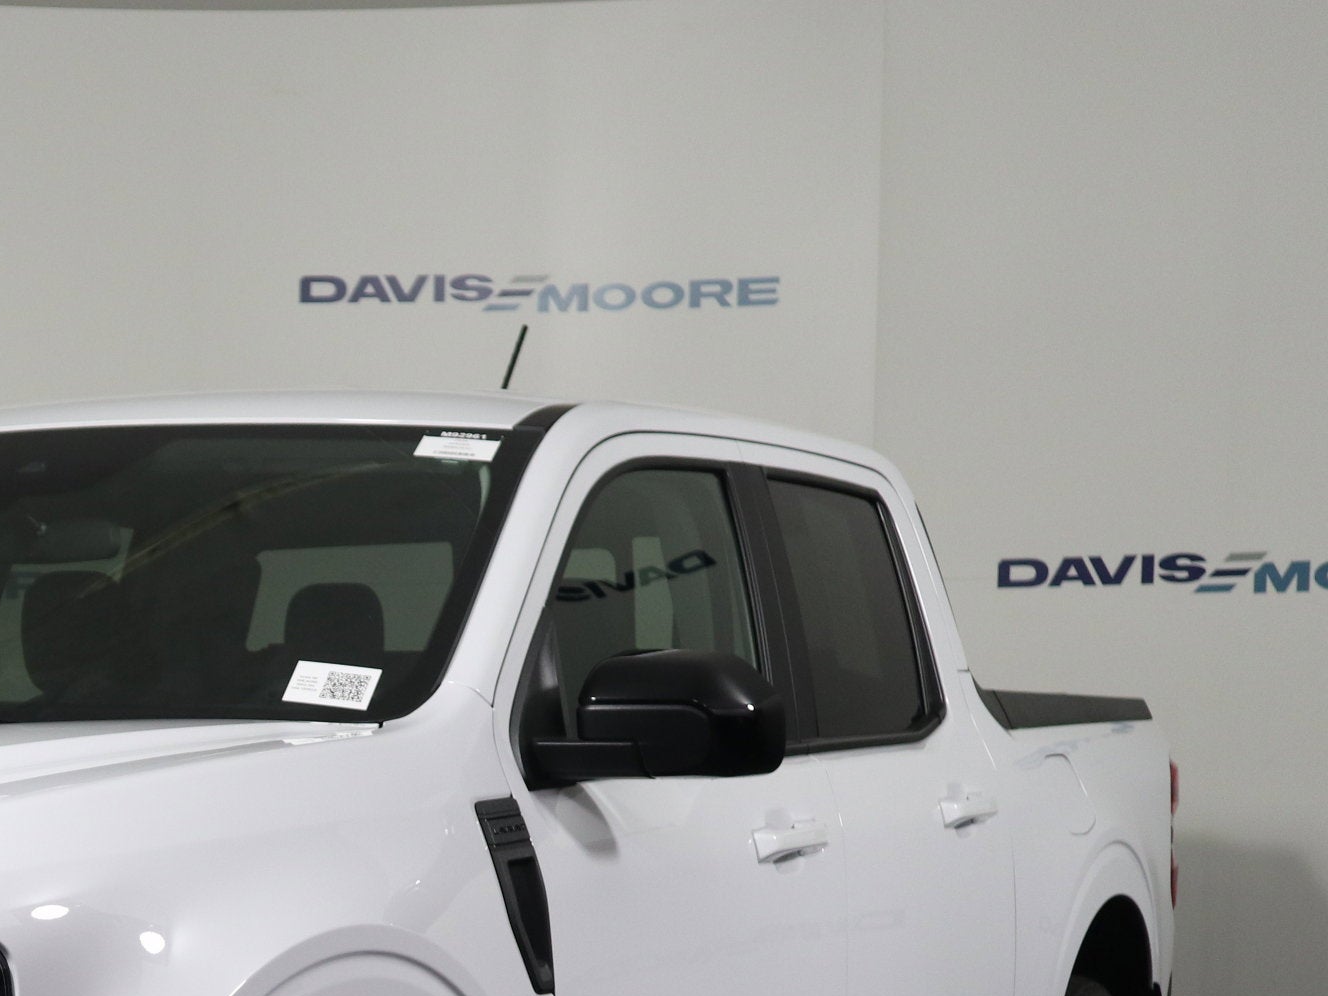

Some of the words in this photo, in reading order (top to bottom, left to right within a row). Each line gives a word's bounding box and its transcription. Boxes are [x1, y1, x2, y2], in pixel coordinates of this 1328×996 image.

[299, 274, 494, 304] DAVIS
[536, 276, 780, 313] MOORE
[997, 552, 1207, 589] DAVIS
